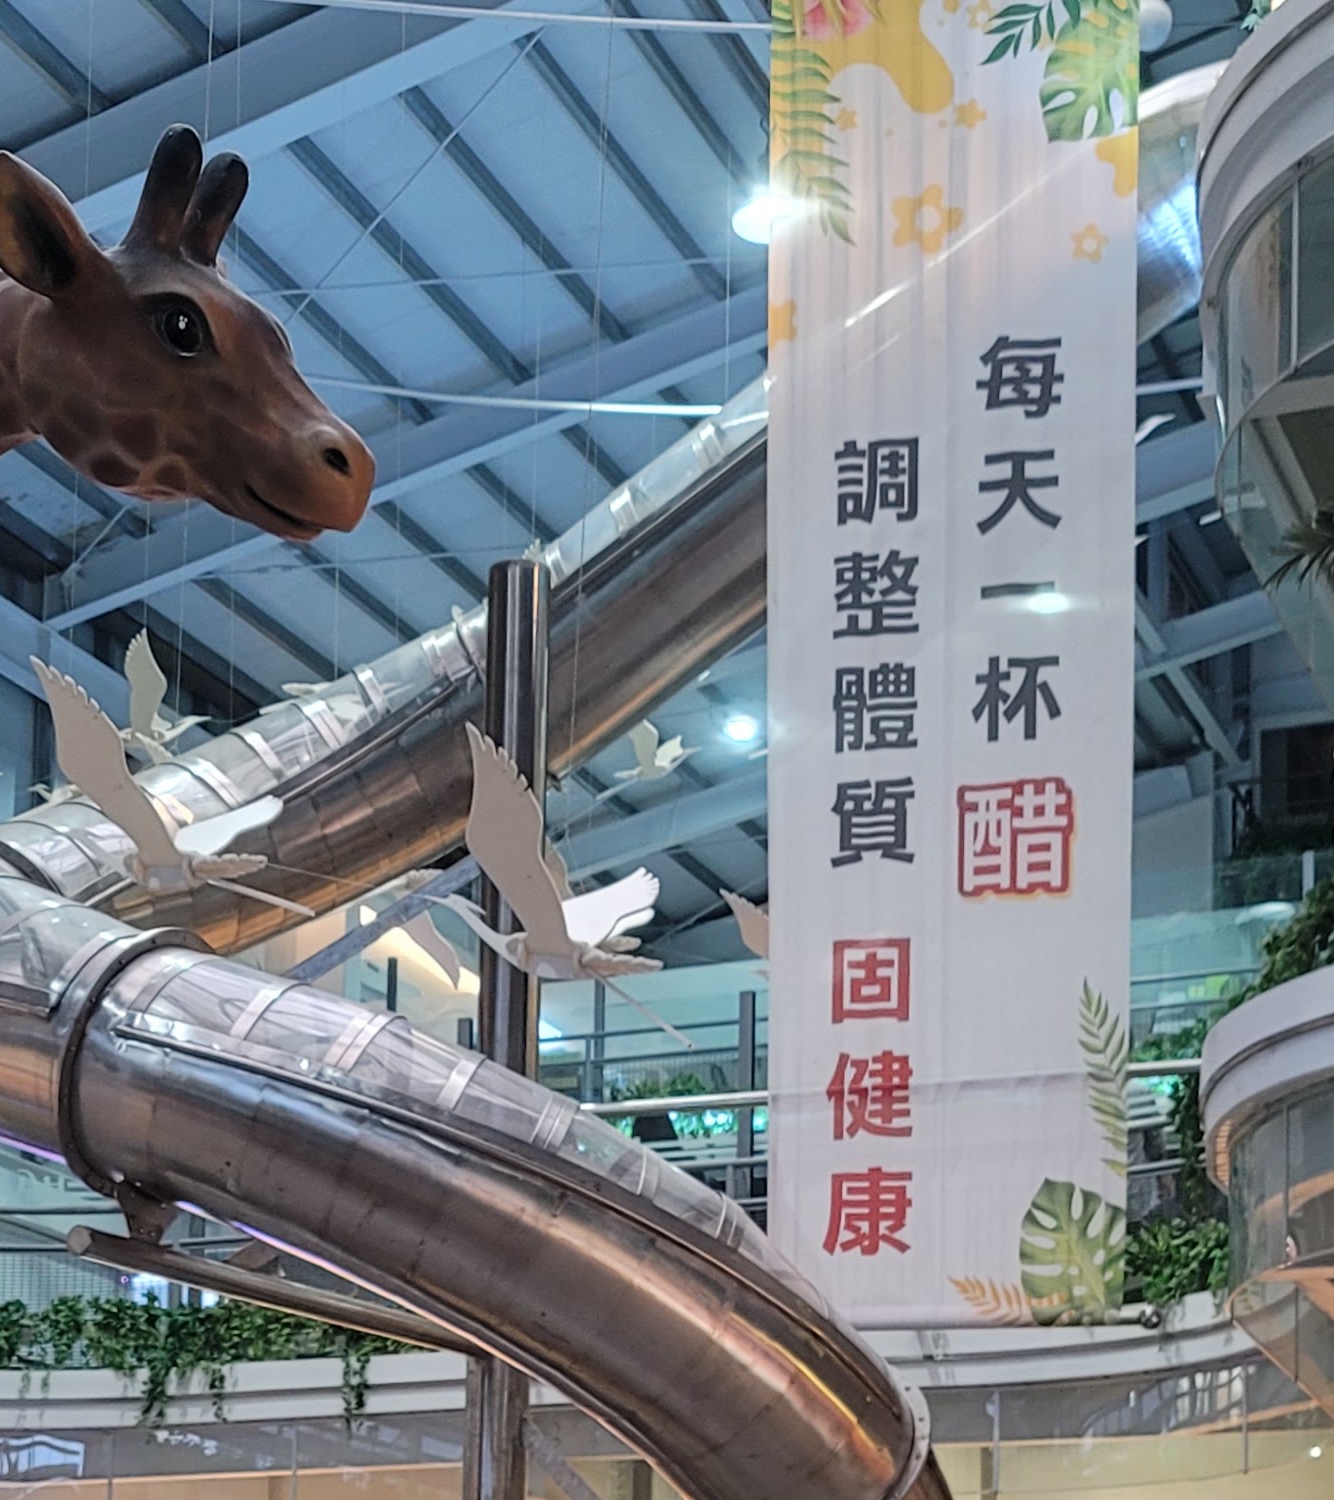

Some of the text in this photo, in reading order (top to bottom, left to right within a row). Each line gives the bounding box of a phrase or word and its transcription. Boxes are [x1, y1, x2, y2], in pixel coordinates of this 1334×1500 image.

[823, 437, 919, 1256] 調整體質 固健康
[964, 335, 1070, 892] 每天一杯醋
